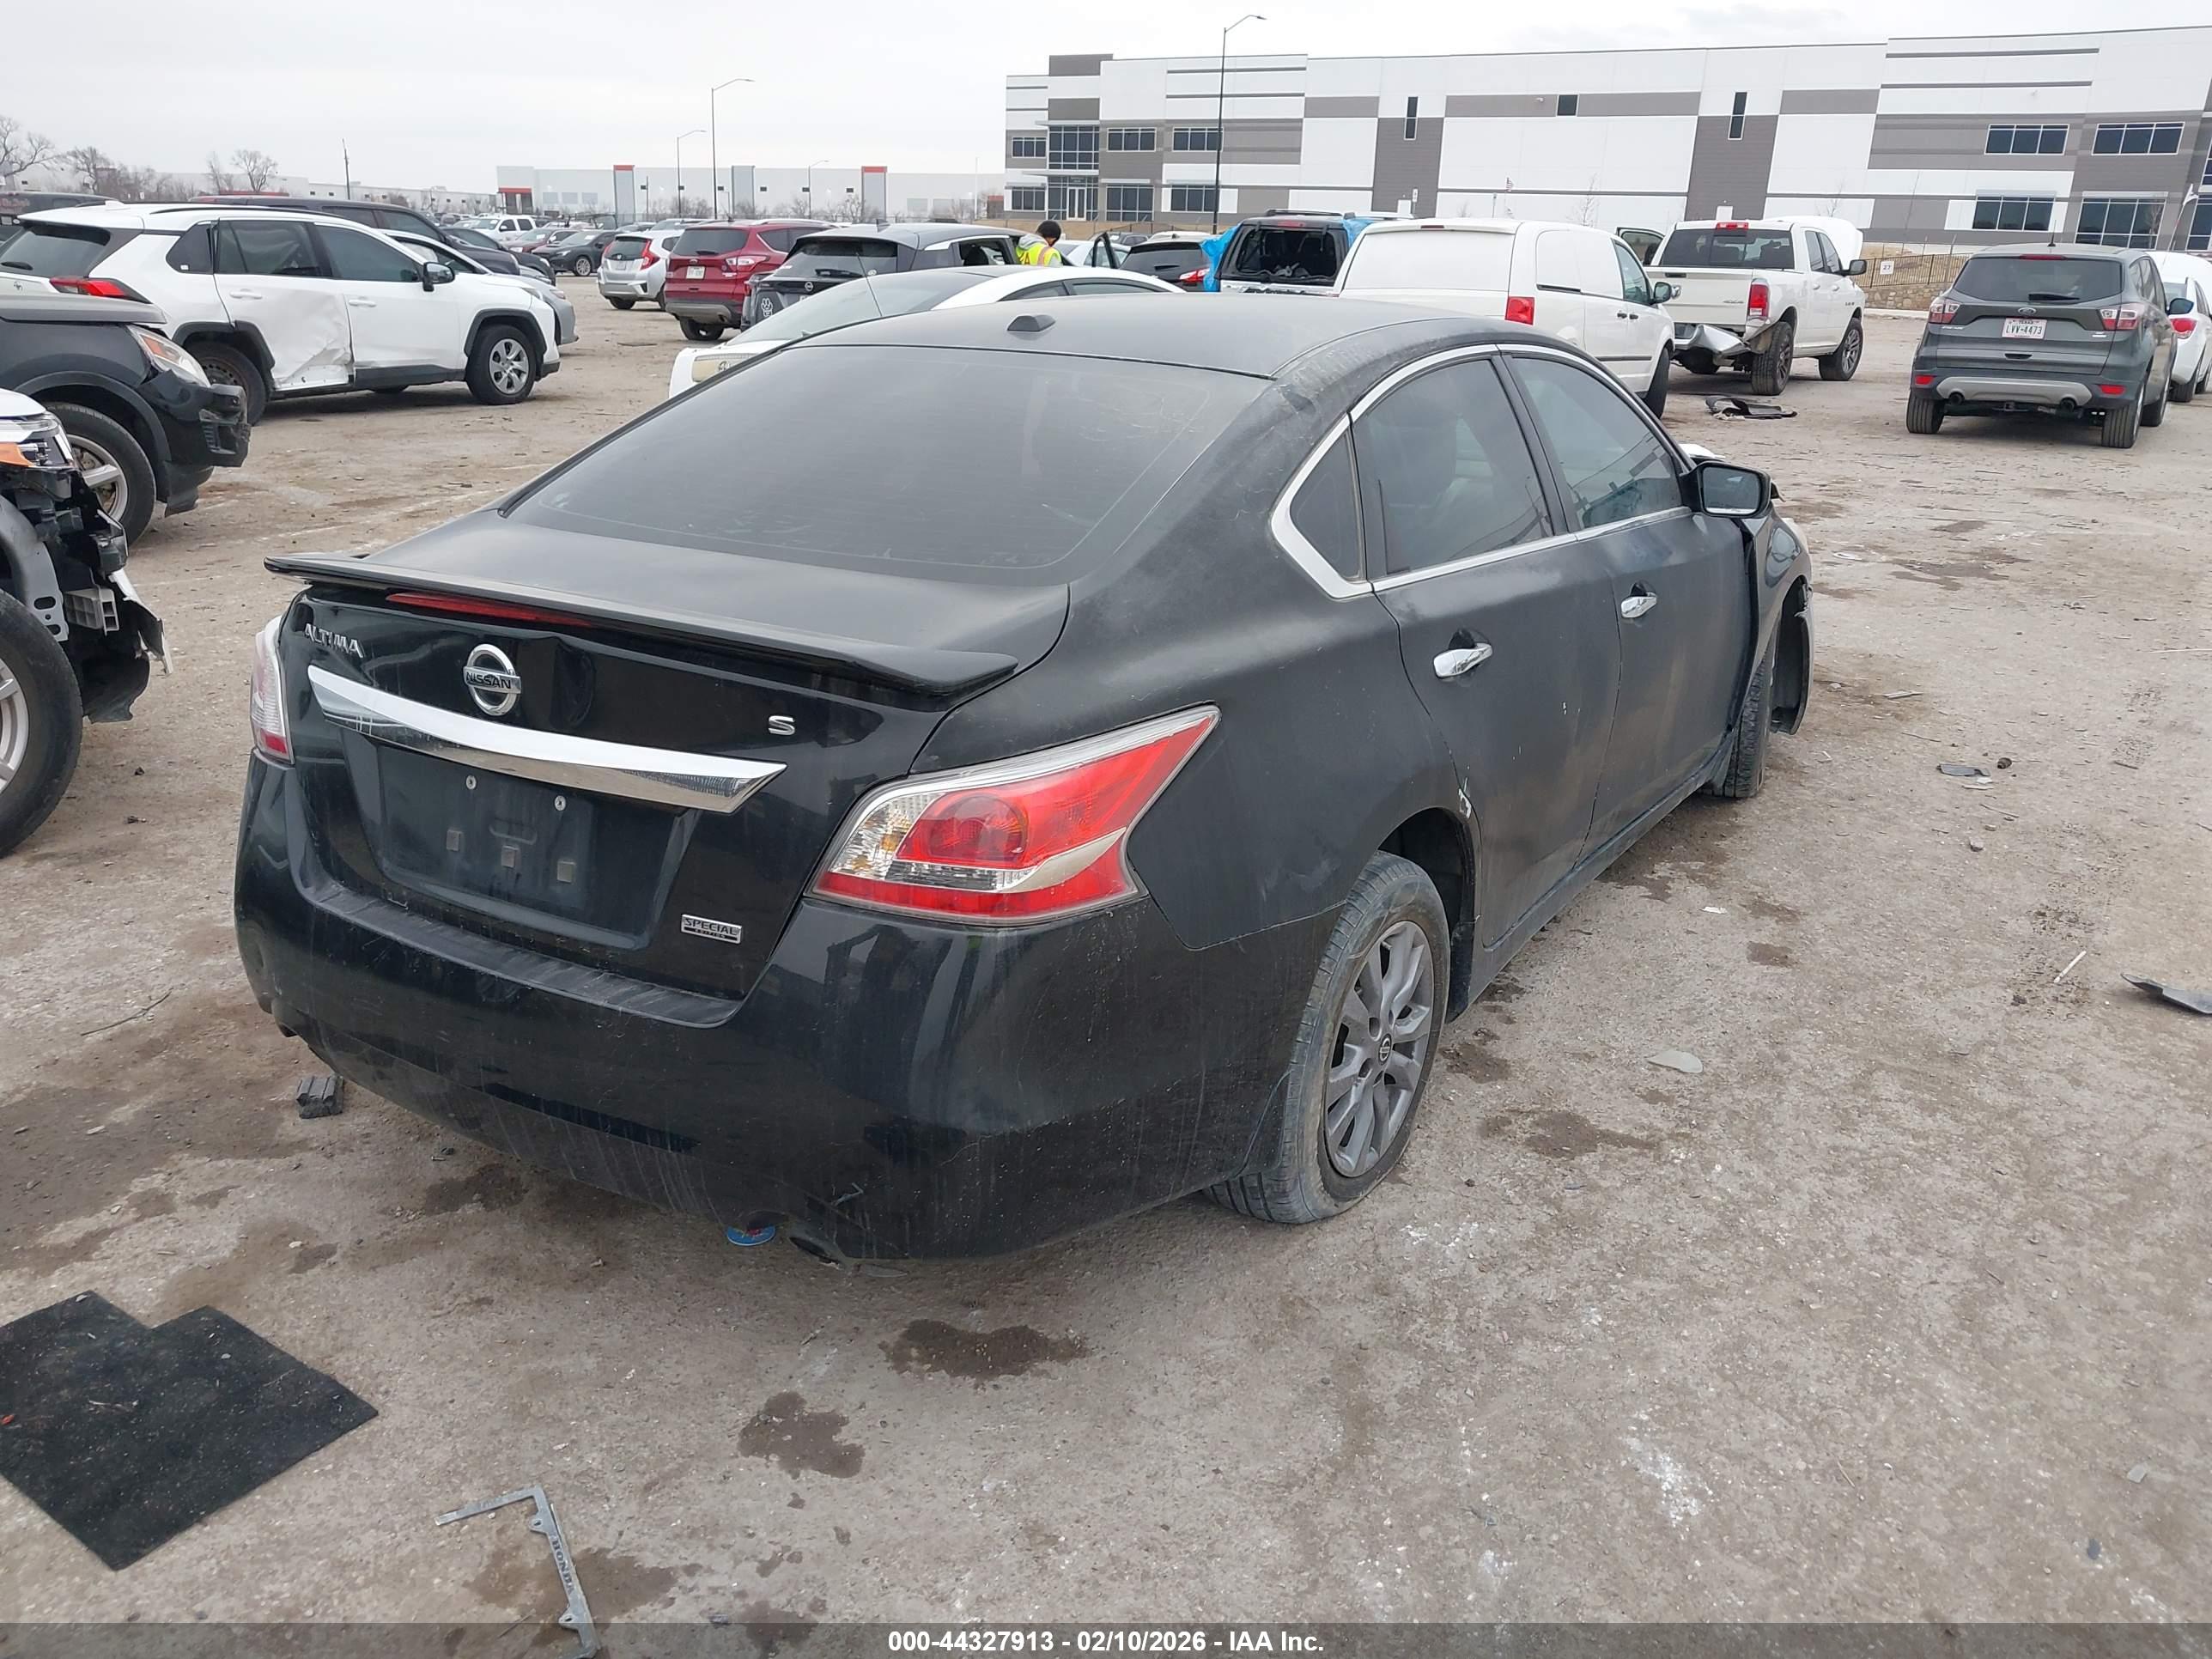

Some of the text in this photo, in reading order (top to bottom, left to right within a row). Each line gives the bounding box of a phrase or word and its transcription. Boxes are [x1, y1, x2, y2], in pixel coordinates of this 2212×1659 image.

[305, 623, 363, 659] ALTIMA
[466, 672, 512, 689] NISSAN
[768, 715, 795, 736] S
[684, 918, 738, 935] SPECIAL
[550, 1539, 575, 1595] HONDA
